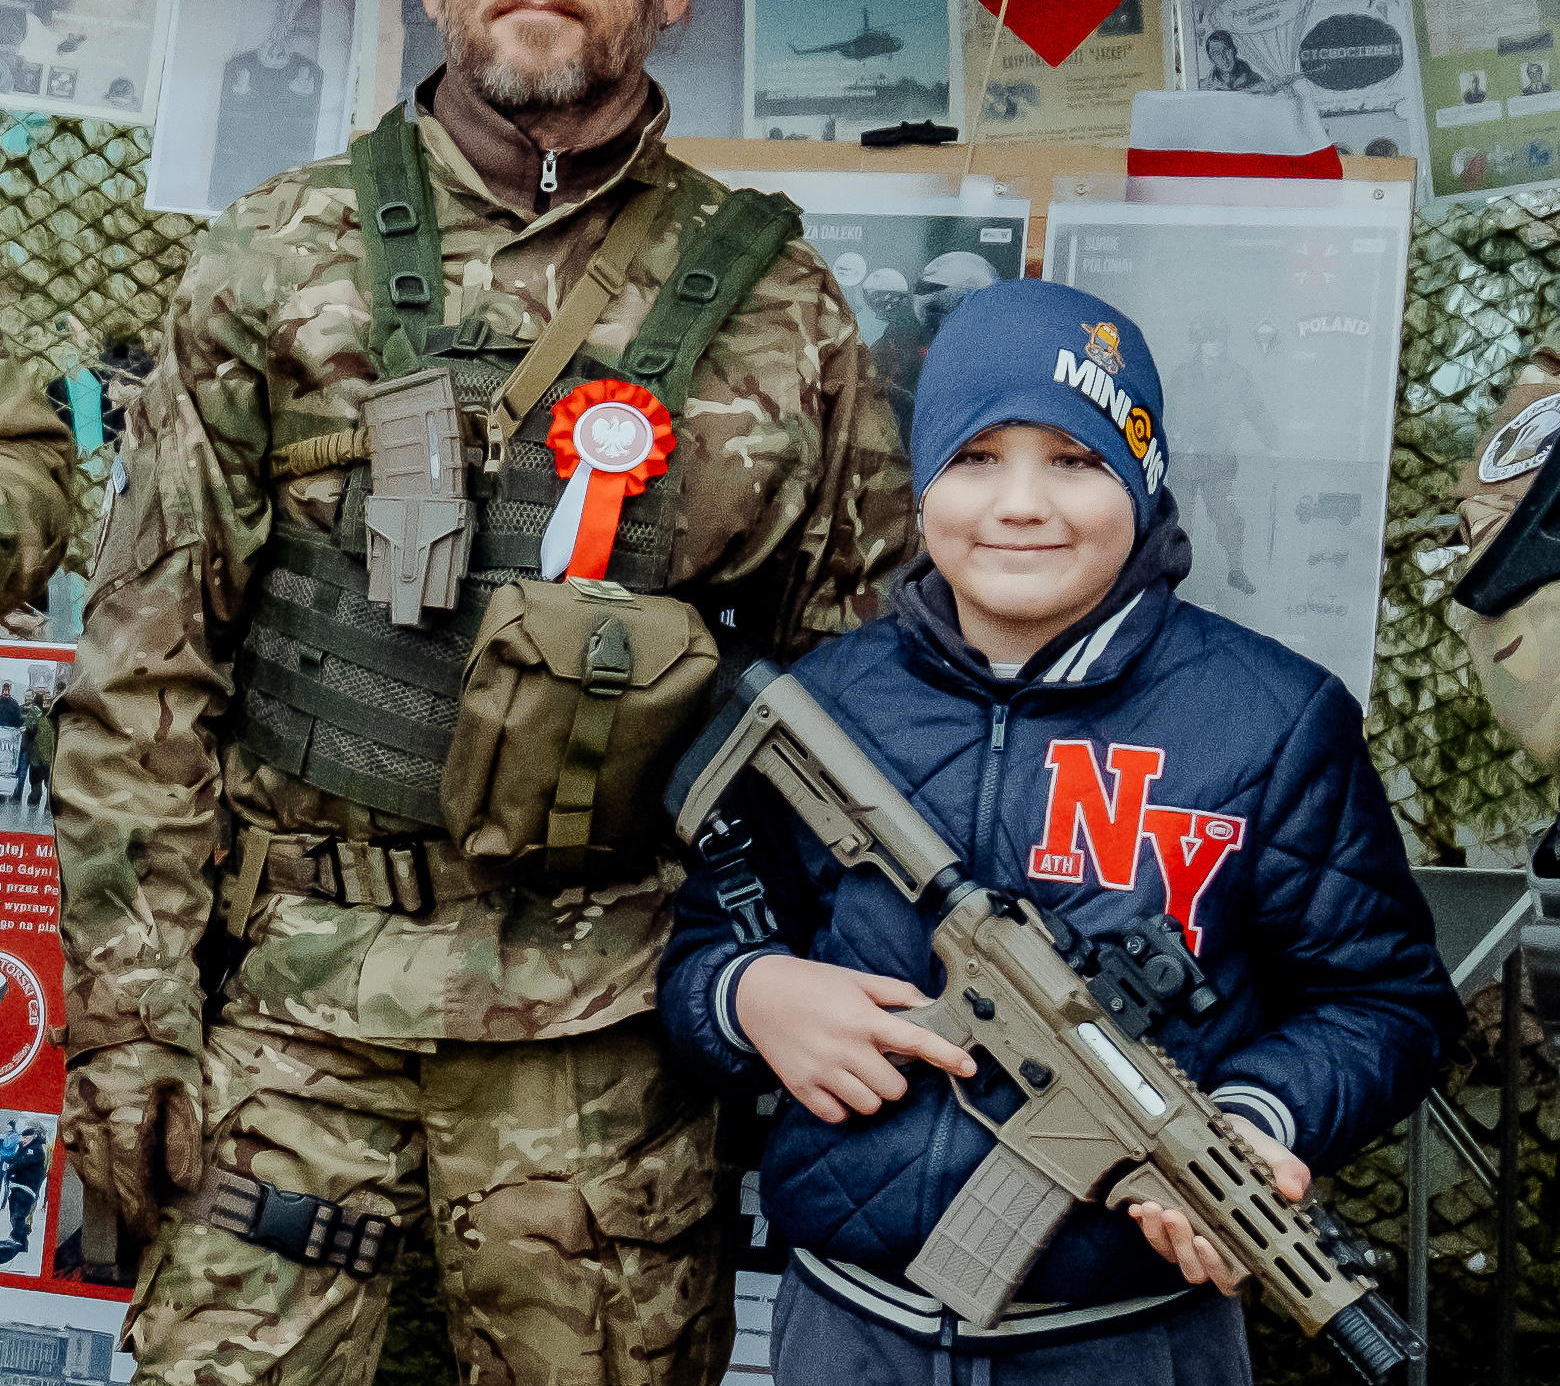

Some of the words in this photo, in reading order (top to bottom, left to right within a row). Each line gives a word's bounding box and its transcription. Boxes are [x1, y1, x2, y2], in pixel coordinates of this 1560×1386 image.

[1297, 315, 1371, 337] POLAND
[1052, 347, 1165, 496] MINIONS
[5, 883, 39, 895] przez
[4, 901, 56, 916] wyprawy
[18, 920, 34, 931] na
